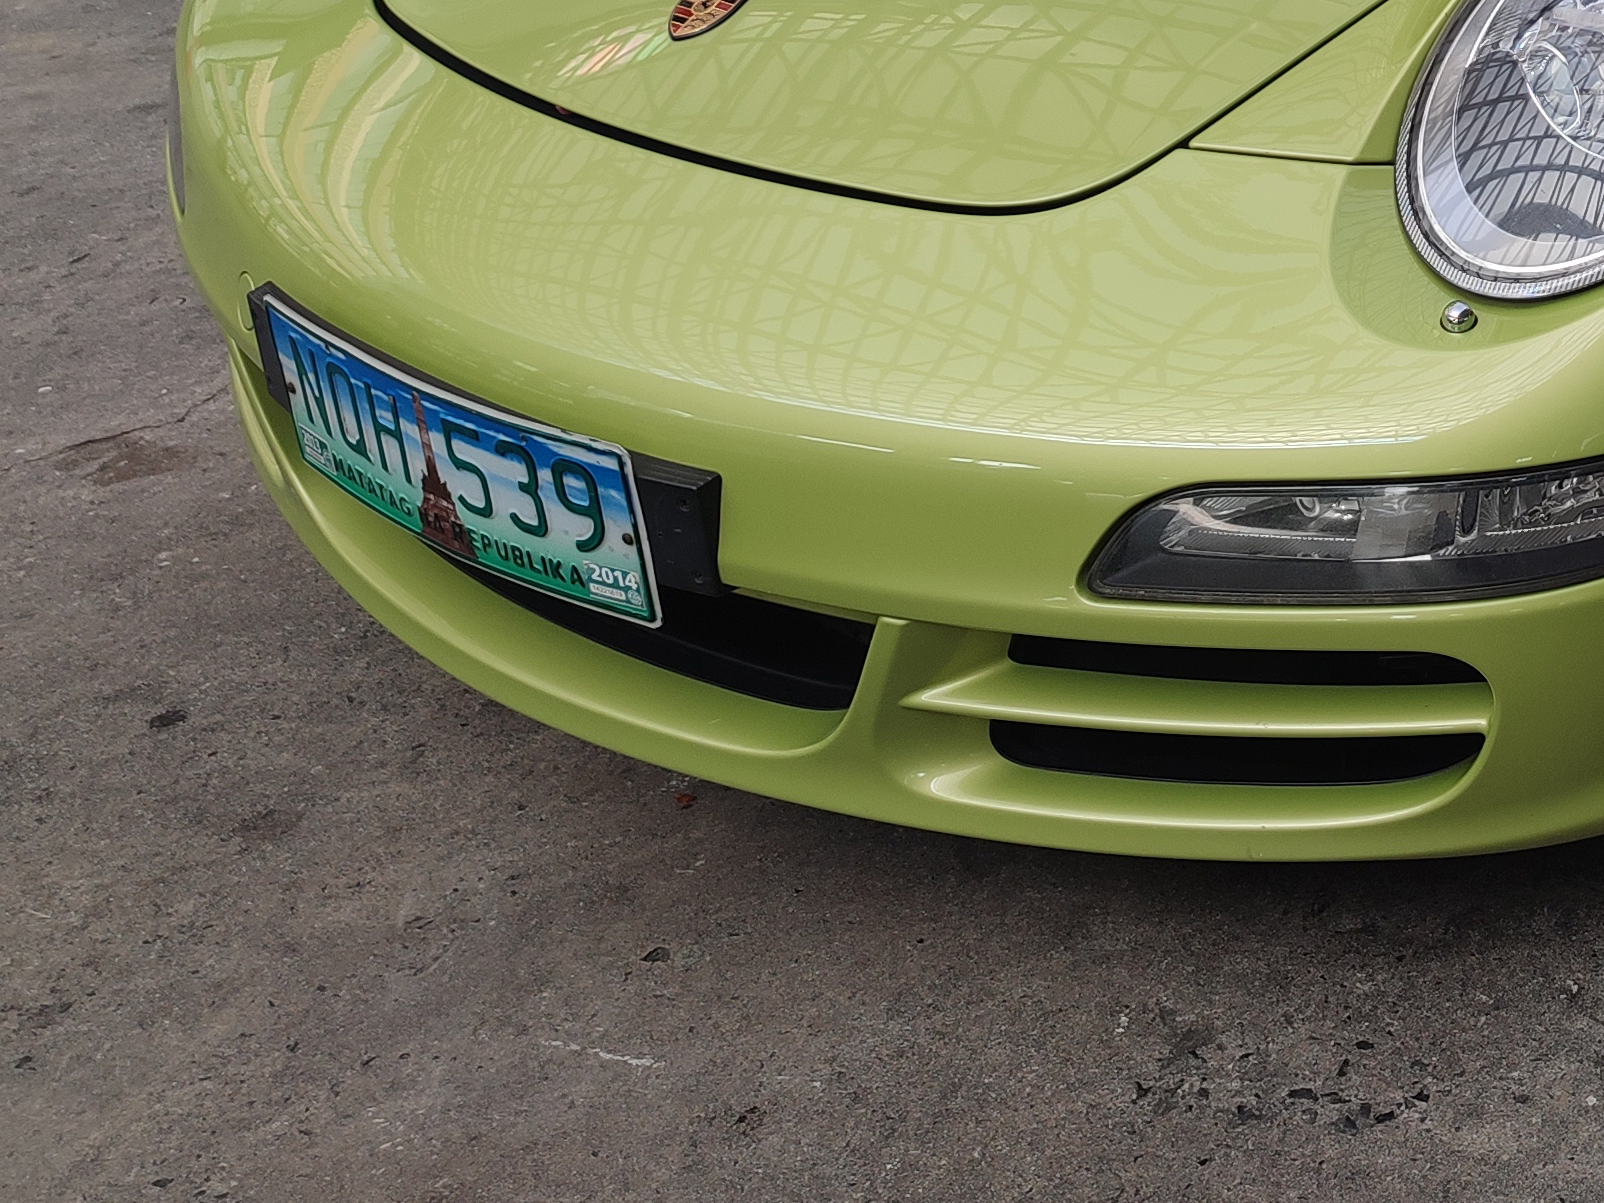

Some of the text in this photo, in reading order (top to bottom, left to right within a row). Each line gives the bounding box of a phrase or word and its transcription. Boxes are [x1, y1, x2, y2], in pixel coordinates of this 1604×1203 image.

[289, 334, 605, 552] NQH 539
[332, 451, 585, 588] MATATAG NA REPUBLIKA
[588, 563, 638, 590] 2014
